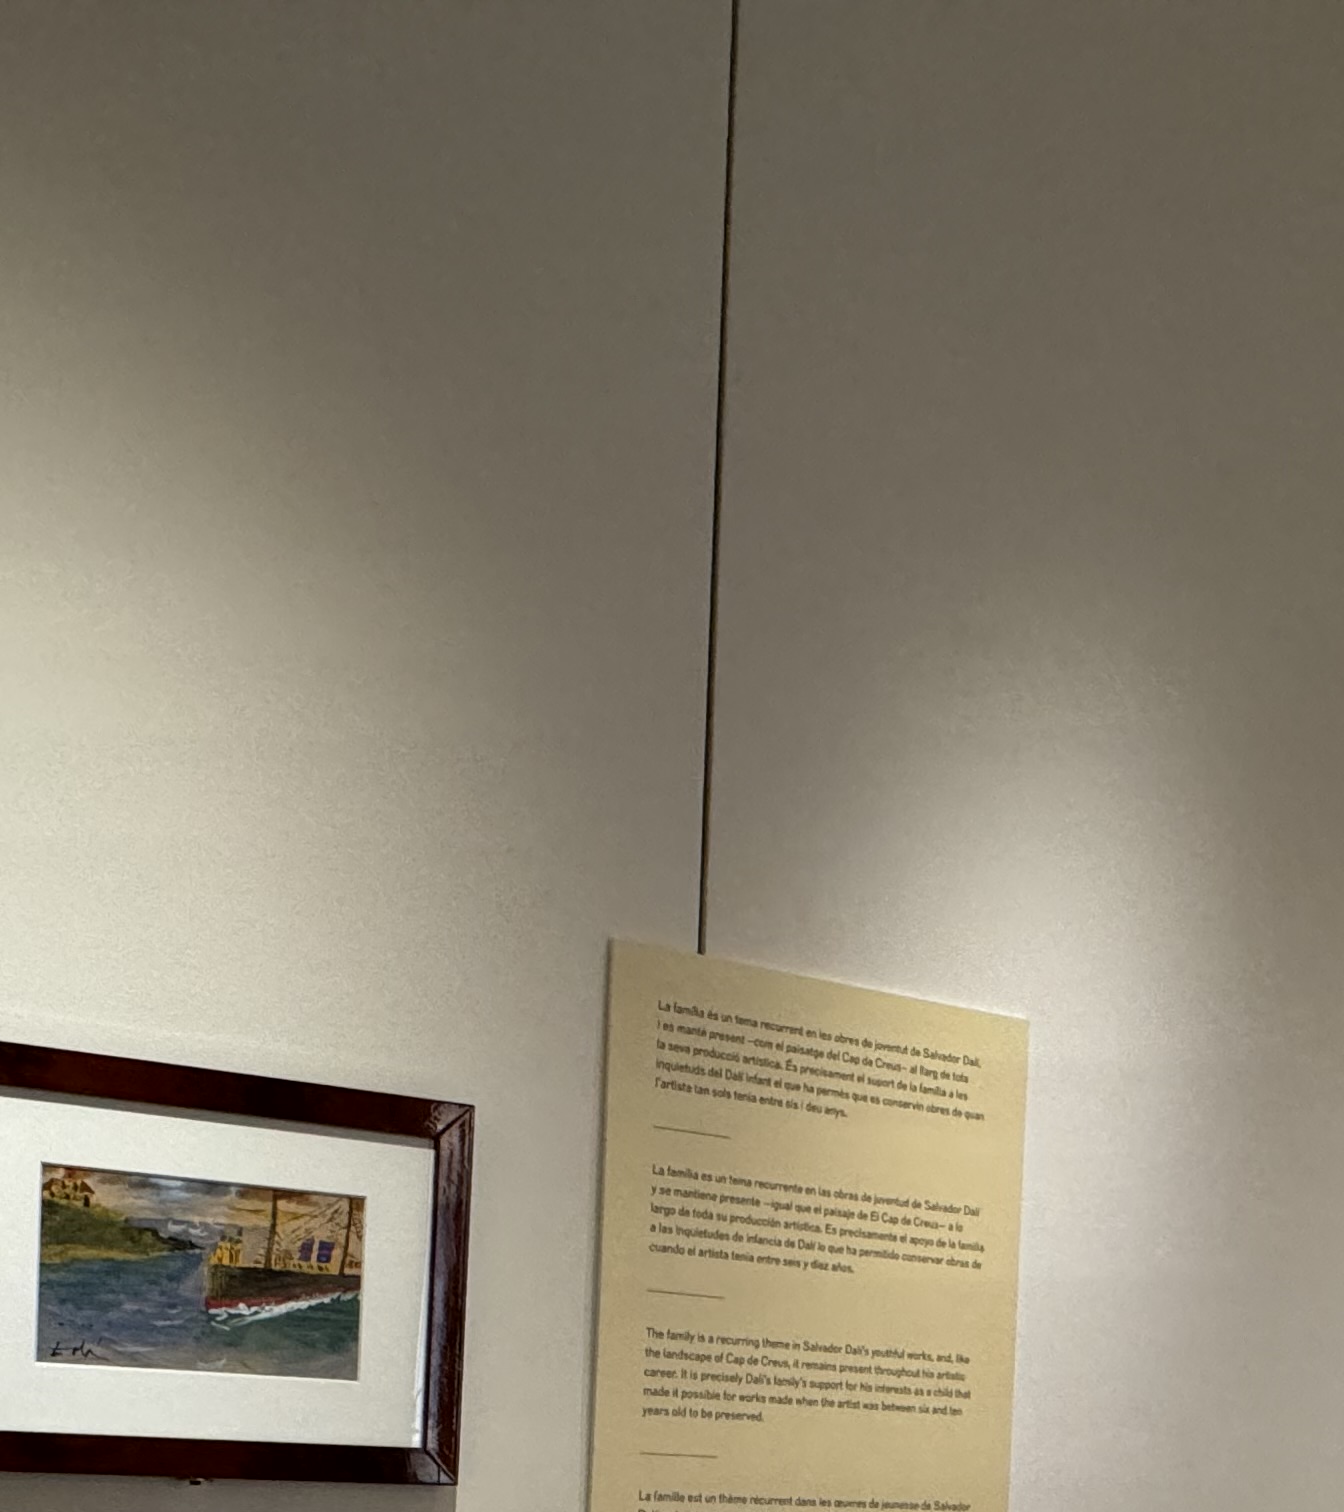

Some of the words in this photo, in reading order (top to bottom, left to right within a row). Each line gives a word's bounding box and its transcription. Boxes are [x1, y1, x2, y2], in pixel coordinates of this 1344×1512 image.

[657, 999, 671, 1013] La
[720, 1013, 733, 1024] un
[734, 1013, 758, 1028] tema
[759, 1017, 804, 1036] recurrent
[708, 1027, 745, 1047] present
[667, 1042, 690, 1055] seva
[784, 1057, 798, 1072] És
[655, 1057, 706, 1080] inquietuds
[707, 1066, 723, 1080] del
[745, 1072, 772, 1087] infant
[783, 1081, 801, 1094] que
[693, 1082, 710, 1096] tan
[711, 1085, 731, 1100] sols
[733, 1088, 757, 1104] tenia
[758, 1092, 783, 1108] entre
[785, 1096, 799, 1110] sis
[651, 1164, 665, 1177] La
[666, 1166, 699, 1182] familia
[700, 1173, 713, 1183] es
[714, 1175, 727, 1185] un
[728, 1174, 752, 1188] tema
[753, 1177, 803, 1194] recurrente
[658, 1187, 671, 1197] se
[673, 1186, 717, 1203] mantiene
[718, 1191, 761, 1210] presente
[649, 1202, 676, 1220] largo
[677, 1205, 690, 1219] de
[691, 1207, 714, 1221] toda
[658, 1222, 673, 1236] las
[674, 1224, 730, 1245] inquietudes
[731, 1230, 744, 1243] de
[746, 1232, 782, 1248] infancia
[783, 1236, 796, 1249] de
[648, 1240, 685, 1255] cuando
[697, 1245, 729, 1260] artista
[756, 1251, 781, 1265] entre
[646, 1327, 664, 1340] The
[665, 1328, 695, 1345] family
[715, 1332, 760, 1350] recurring
[761, 1336, 790, 1350] theme
[644, 1346, 661, 1359] the
[662, 1347, 712, 1365] landscape
[725, 1351, 745, 1367] Cap
[746, 1353, 759, 1366] de
[699, 1369, 743, 1386] precisely
[642, 1384, 670, 1398] made
[680, 1387, 721, 1404] possible
[722, 1389, 736, 1402] for
[738, 1390, 766, 1404] works
[768, 1392, 793, 1405] made
[641, 1407, 669, 1420] years
[671, 1405, 687, 1418] old
[700, 1407, 713, 1419] be
[637, 1489, 651, 1502] La
[653, 1490, 685, 1503] famille
[687, 1491, 702, 1504] est
